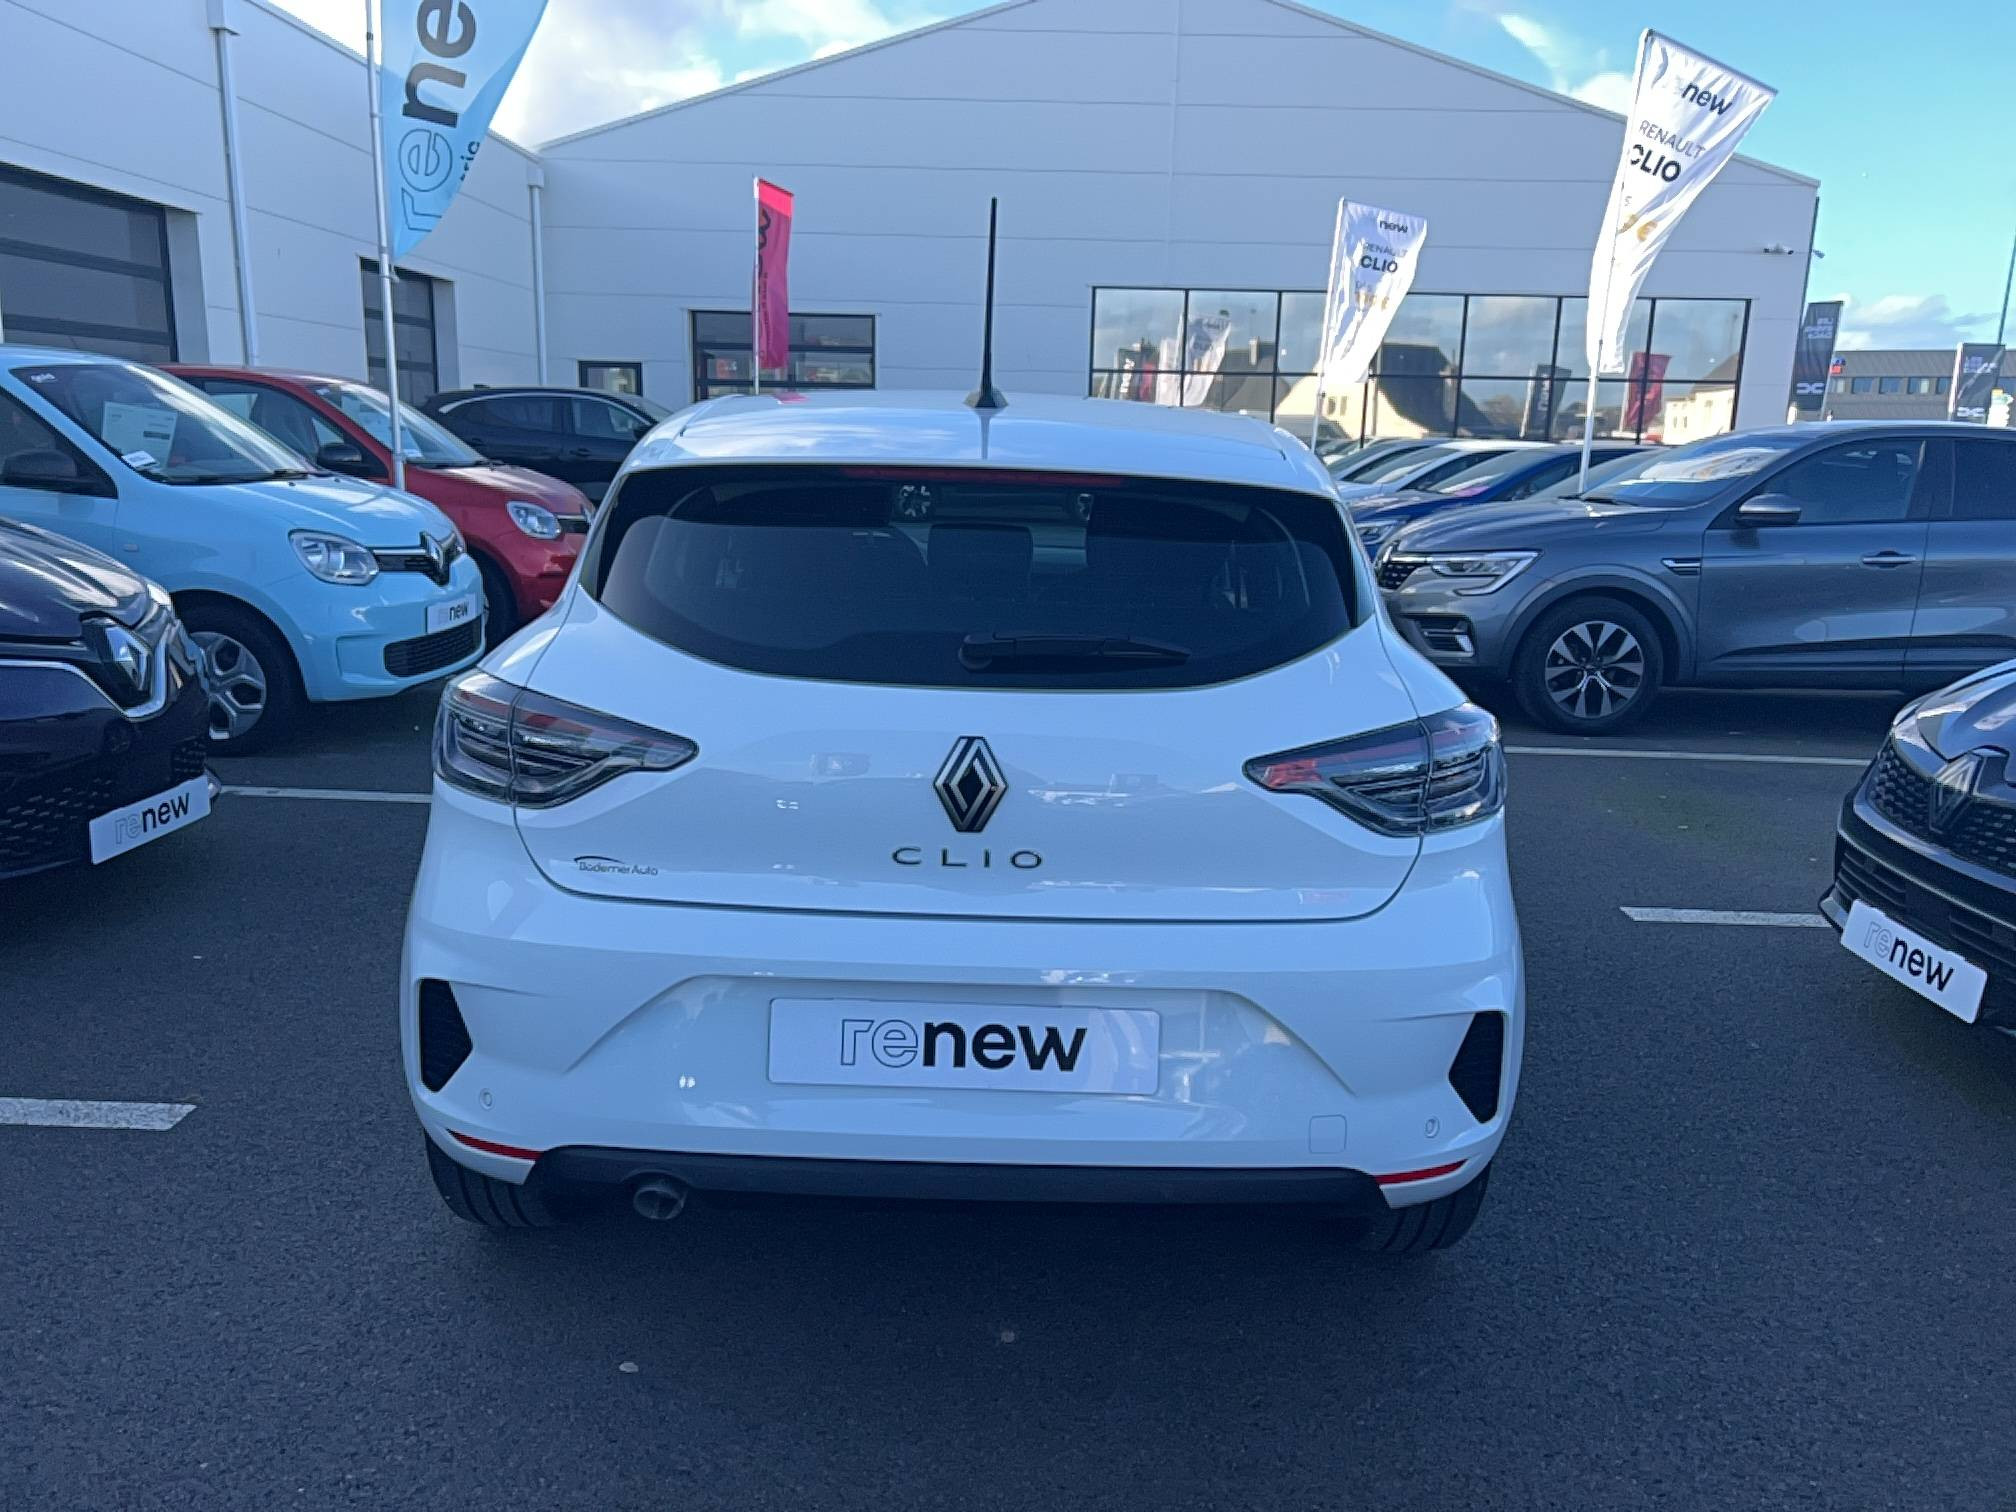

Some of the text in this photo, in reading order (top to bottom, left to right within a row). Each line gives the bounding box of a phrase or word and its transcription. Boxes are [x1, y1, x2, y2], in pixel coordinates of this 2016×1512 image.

[1639, 119, 1706, 159] RENAULT
[1629, 143, 1681, 182] CLIO
[1360, 254, 1398, 274] CLIO
[113, 791, 190, 846] renew
[631, 864, 658, 876] Auto
[892, 846, 1043, 869] CLIO
[1863, 920, 1955, 992] renew
[839, 1017, 1088, 1072] renew
